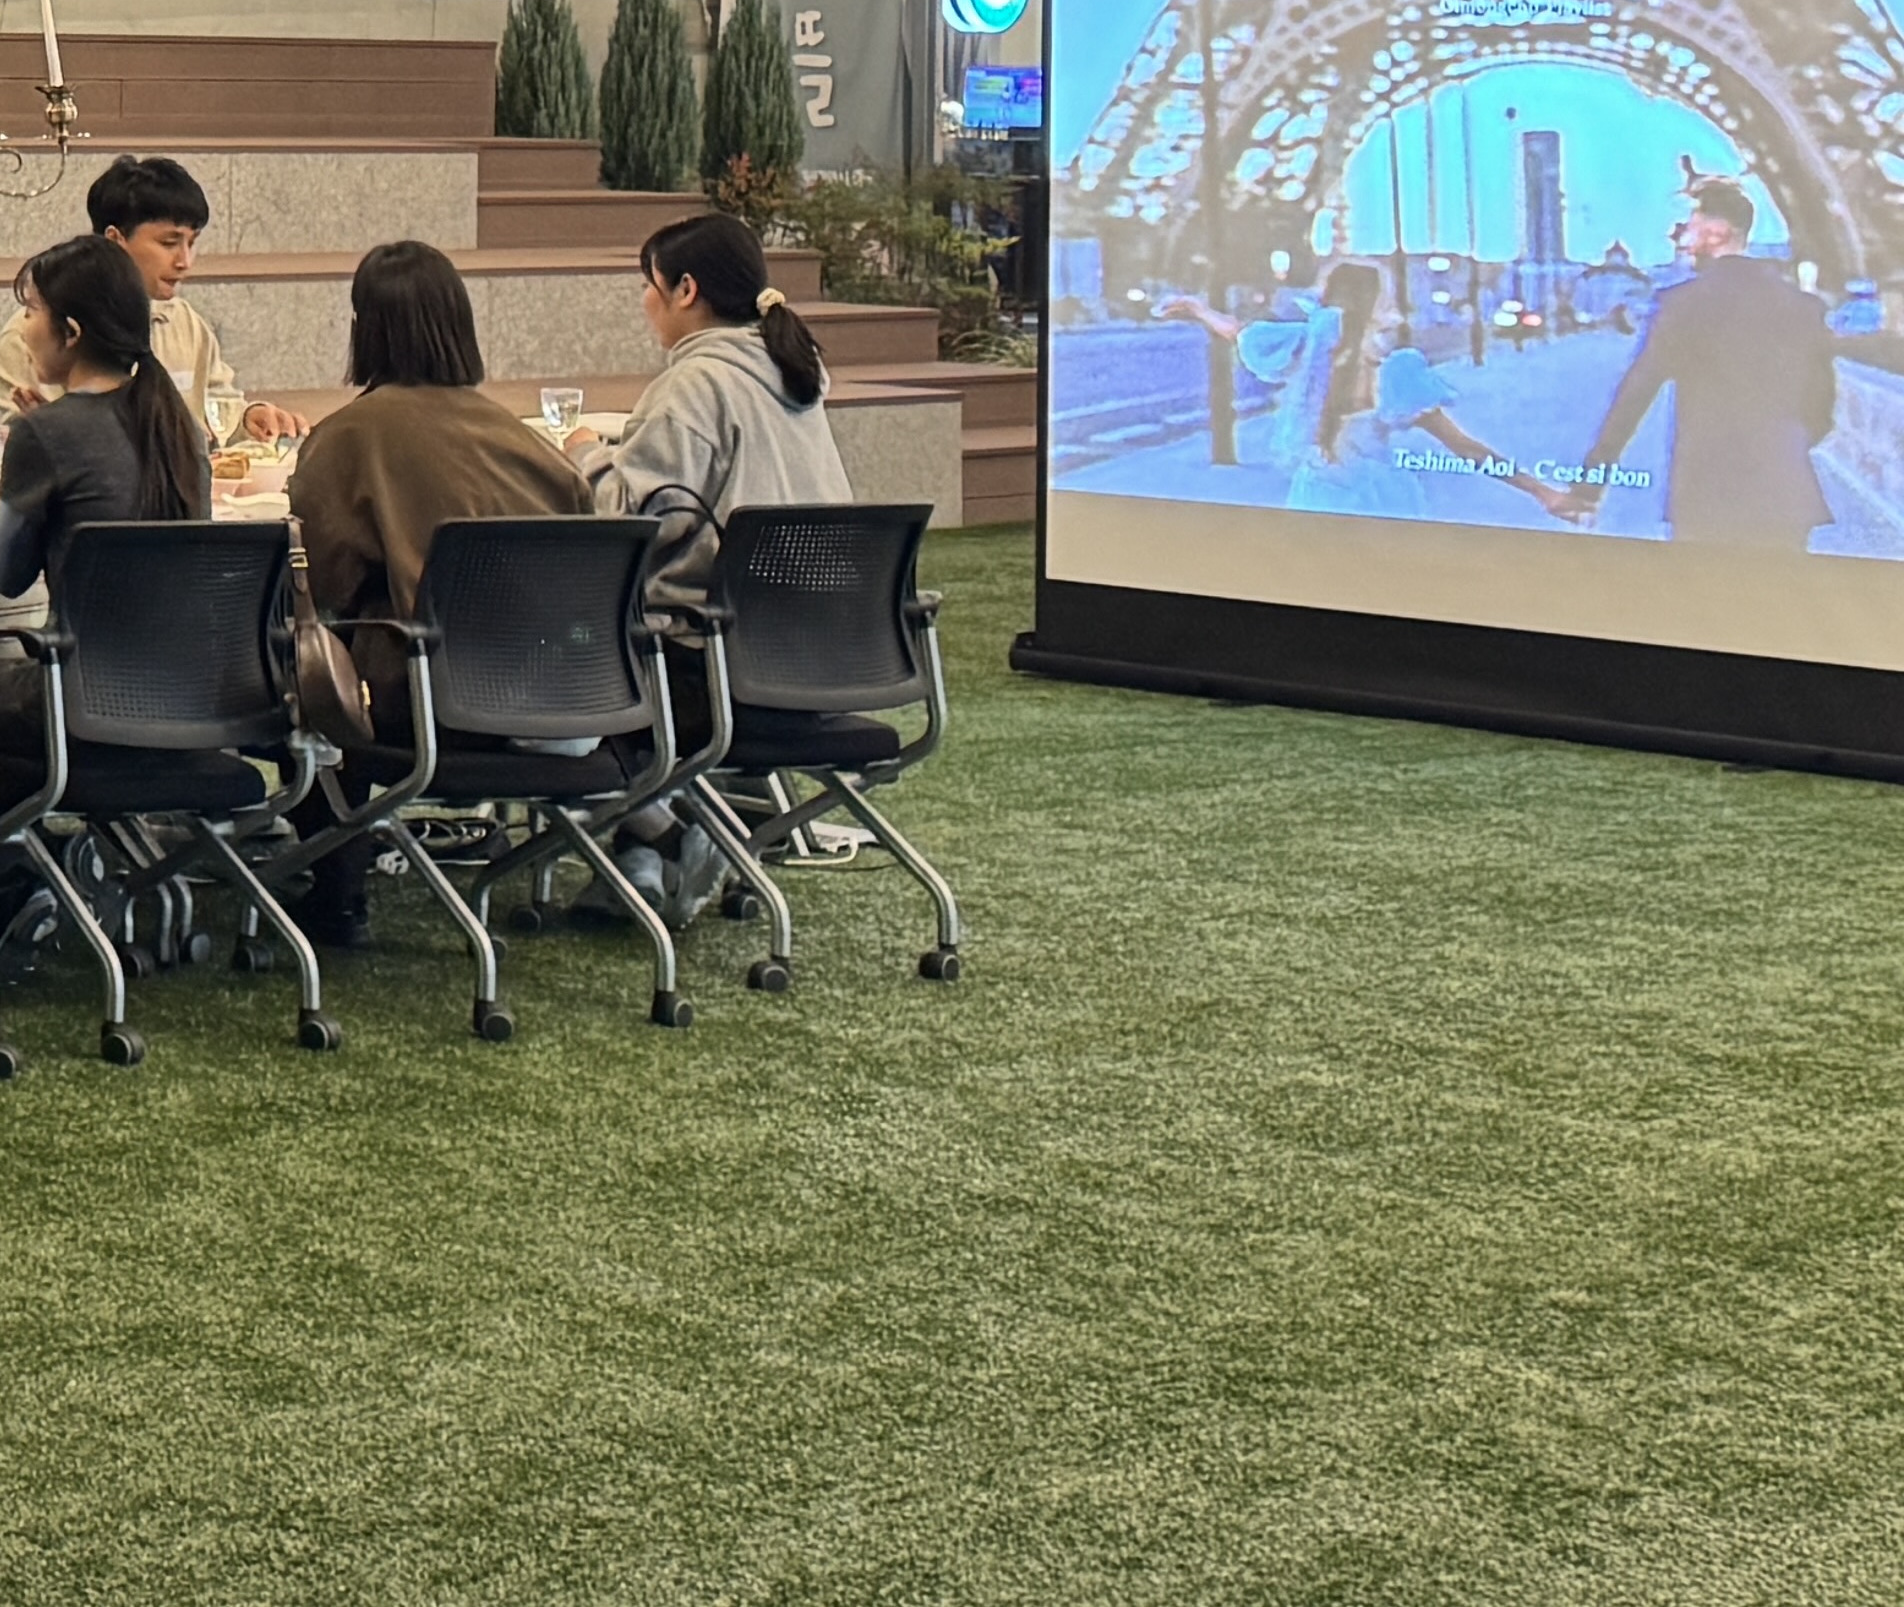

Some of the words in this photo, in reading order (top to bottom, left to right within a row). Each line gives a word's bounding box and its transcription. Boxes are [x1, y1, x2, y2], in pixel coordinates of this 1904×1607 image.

[1394, 448, 1476, 473] Teshima
[1478, 455, 1516, 477] Aoi
[1587, 463, 1605, 485] si
[1610, 465, 1652, 487] bon
